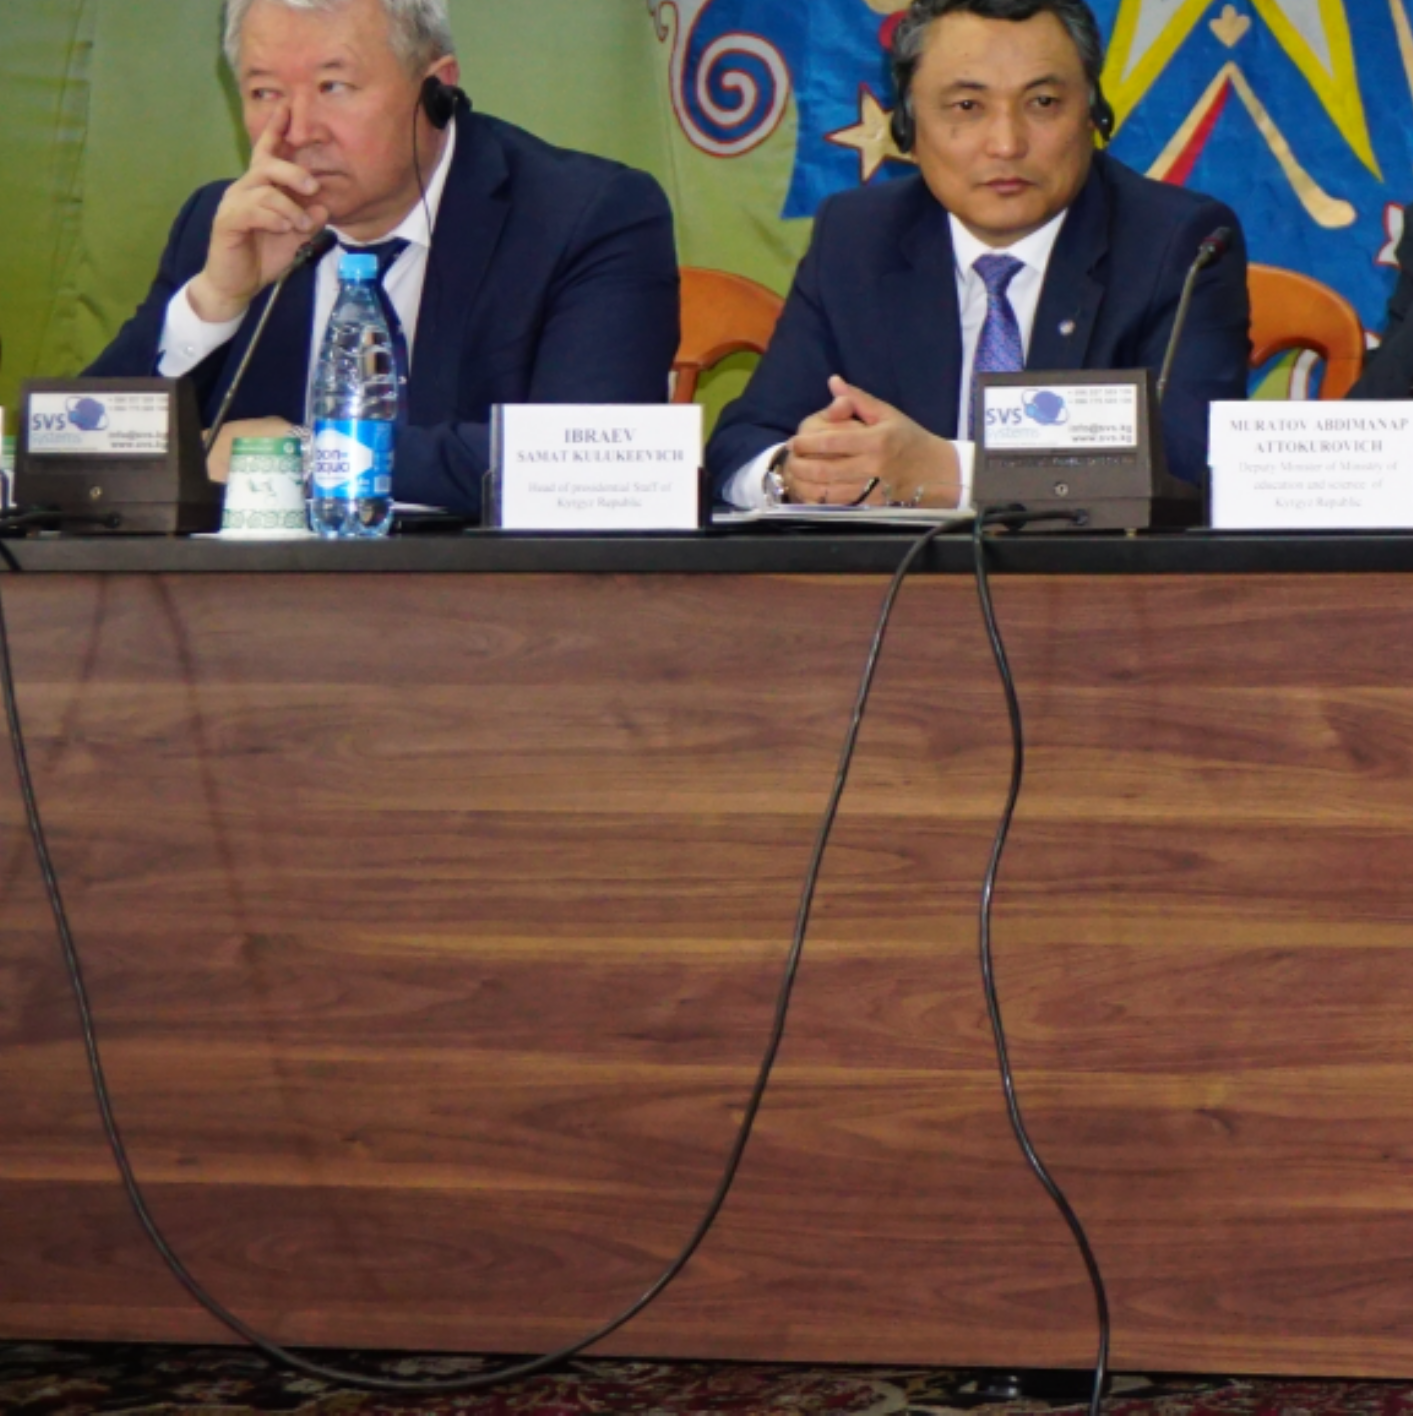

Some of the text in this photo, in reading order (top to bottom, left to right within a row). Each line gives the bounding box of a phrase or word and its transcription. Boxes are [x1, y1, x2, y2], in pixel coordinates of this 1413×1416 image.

[32, 412, 66, 431] SVS
[986, 407, 1023, 425] SVS
[565, 428, 637, 443] IBRAEV
[517, 450, 567, 463] SAMAT
